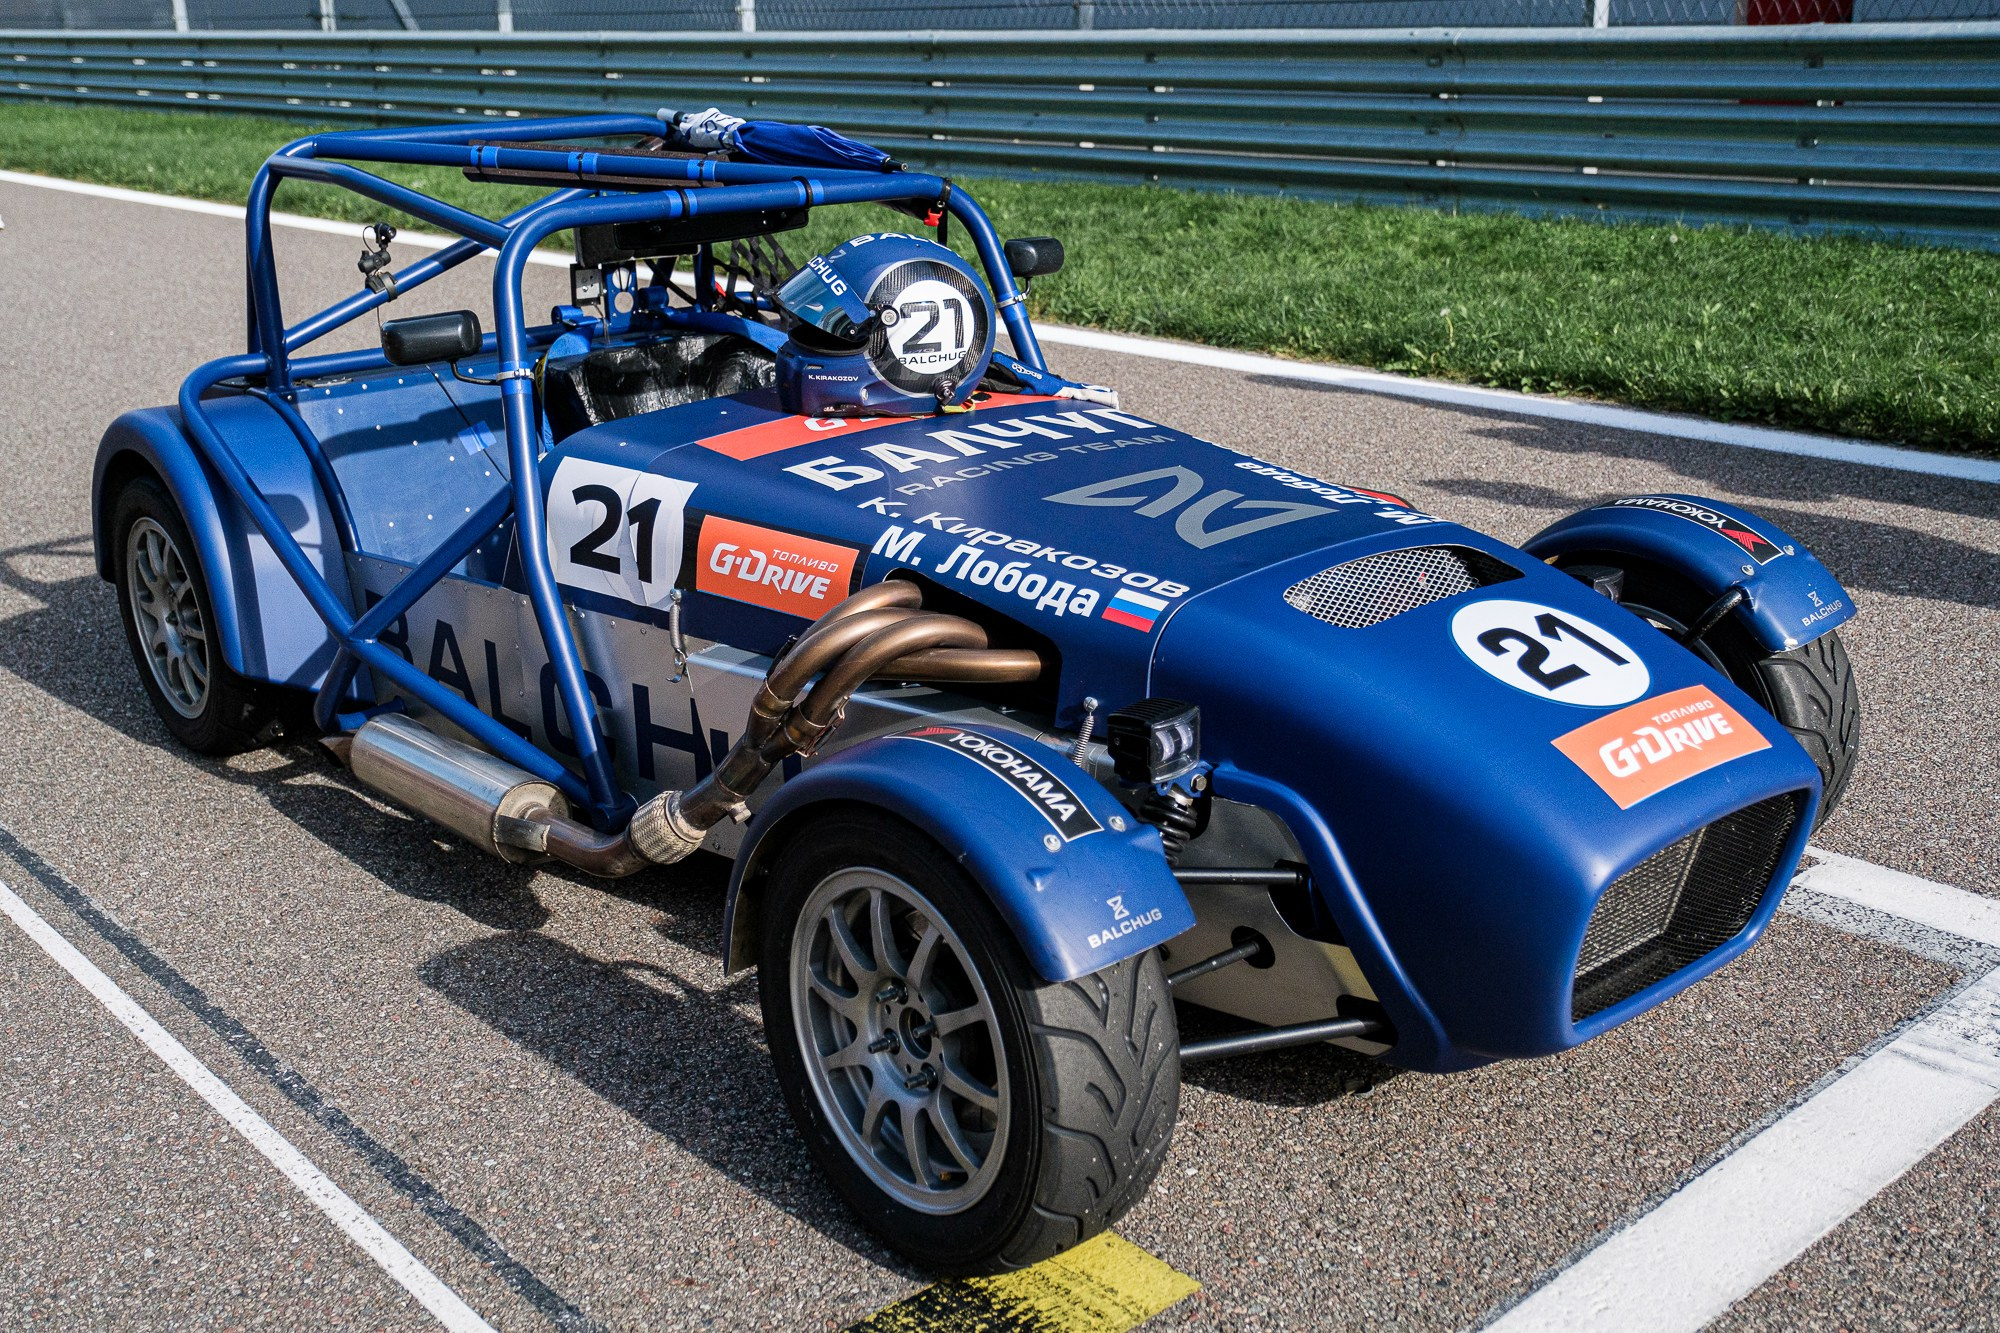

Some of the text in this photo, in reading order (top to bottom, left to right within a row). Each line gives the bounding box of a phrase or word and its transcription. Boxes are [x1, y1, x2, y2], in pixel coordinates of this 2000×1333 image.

[900, 298, 965, 355] 21
[898, 350, 967, 365] BALCHUG
[782, 408, 1158, 491] БАЛЧУГ
[895, 434, 1176, 496] RACING TEAM
[570, 483, 662, 584] 21
[1615, 498, 1727, 529] YOKOHAMA
[772, 549, 839, 573] ТОПЛИВО
[857, 496, 1191, 599] К. Киракозов
[872, 524, 1100, 618] М. Лобода
[1801, 599, 1843, 627] BALCHUG
[1477, 612, 1631, 691] 21
[1651, 699, 1715, 726] ТОПЛИВО
[949, 732, 1078, 822] YOKOHAMA
[1087, 908, 1163, 949] BALCHUG
